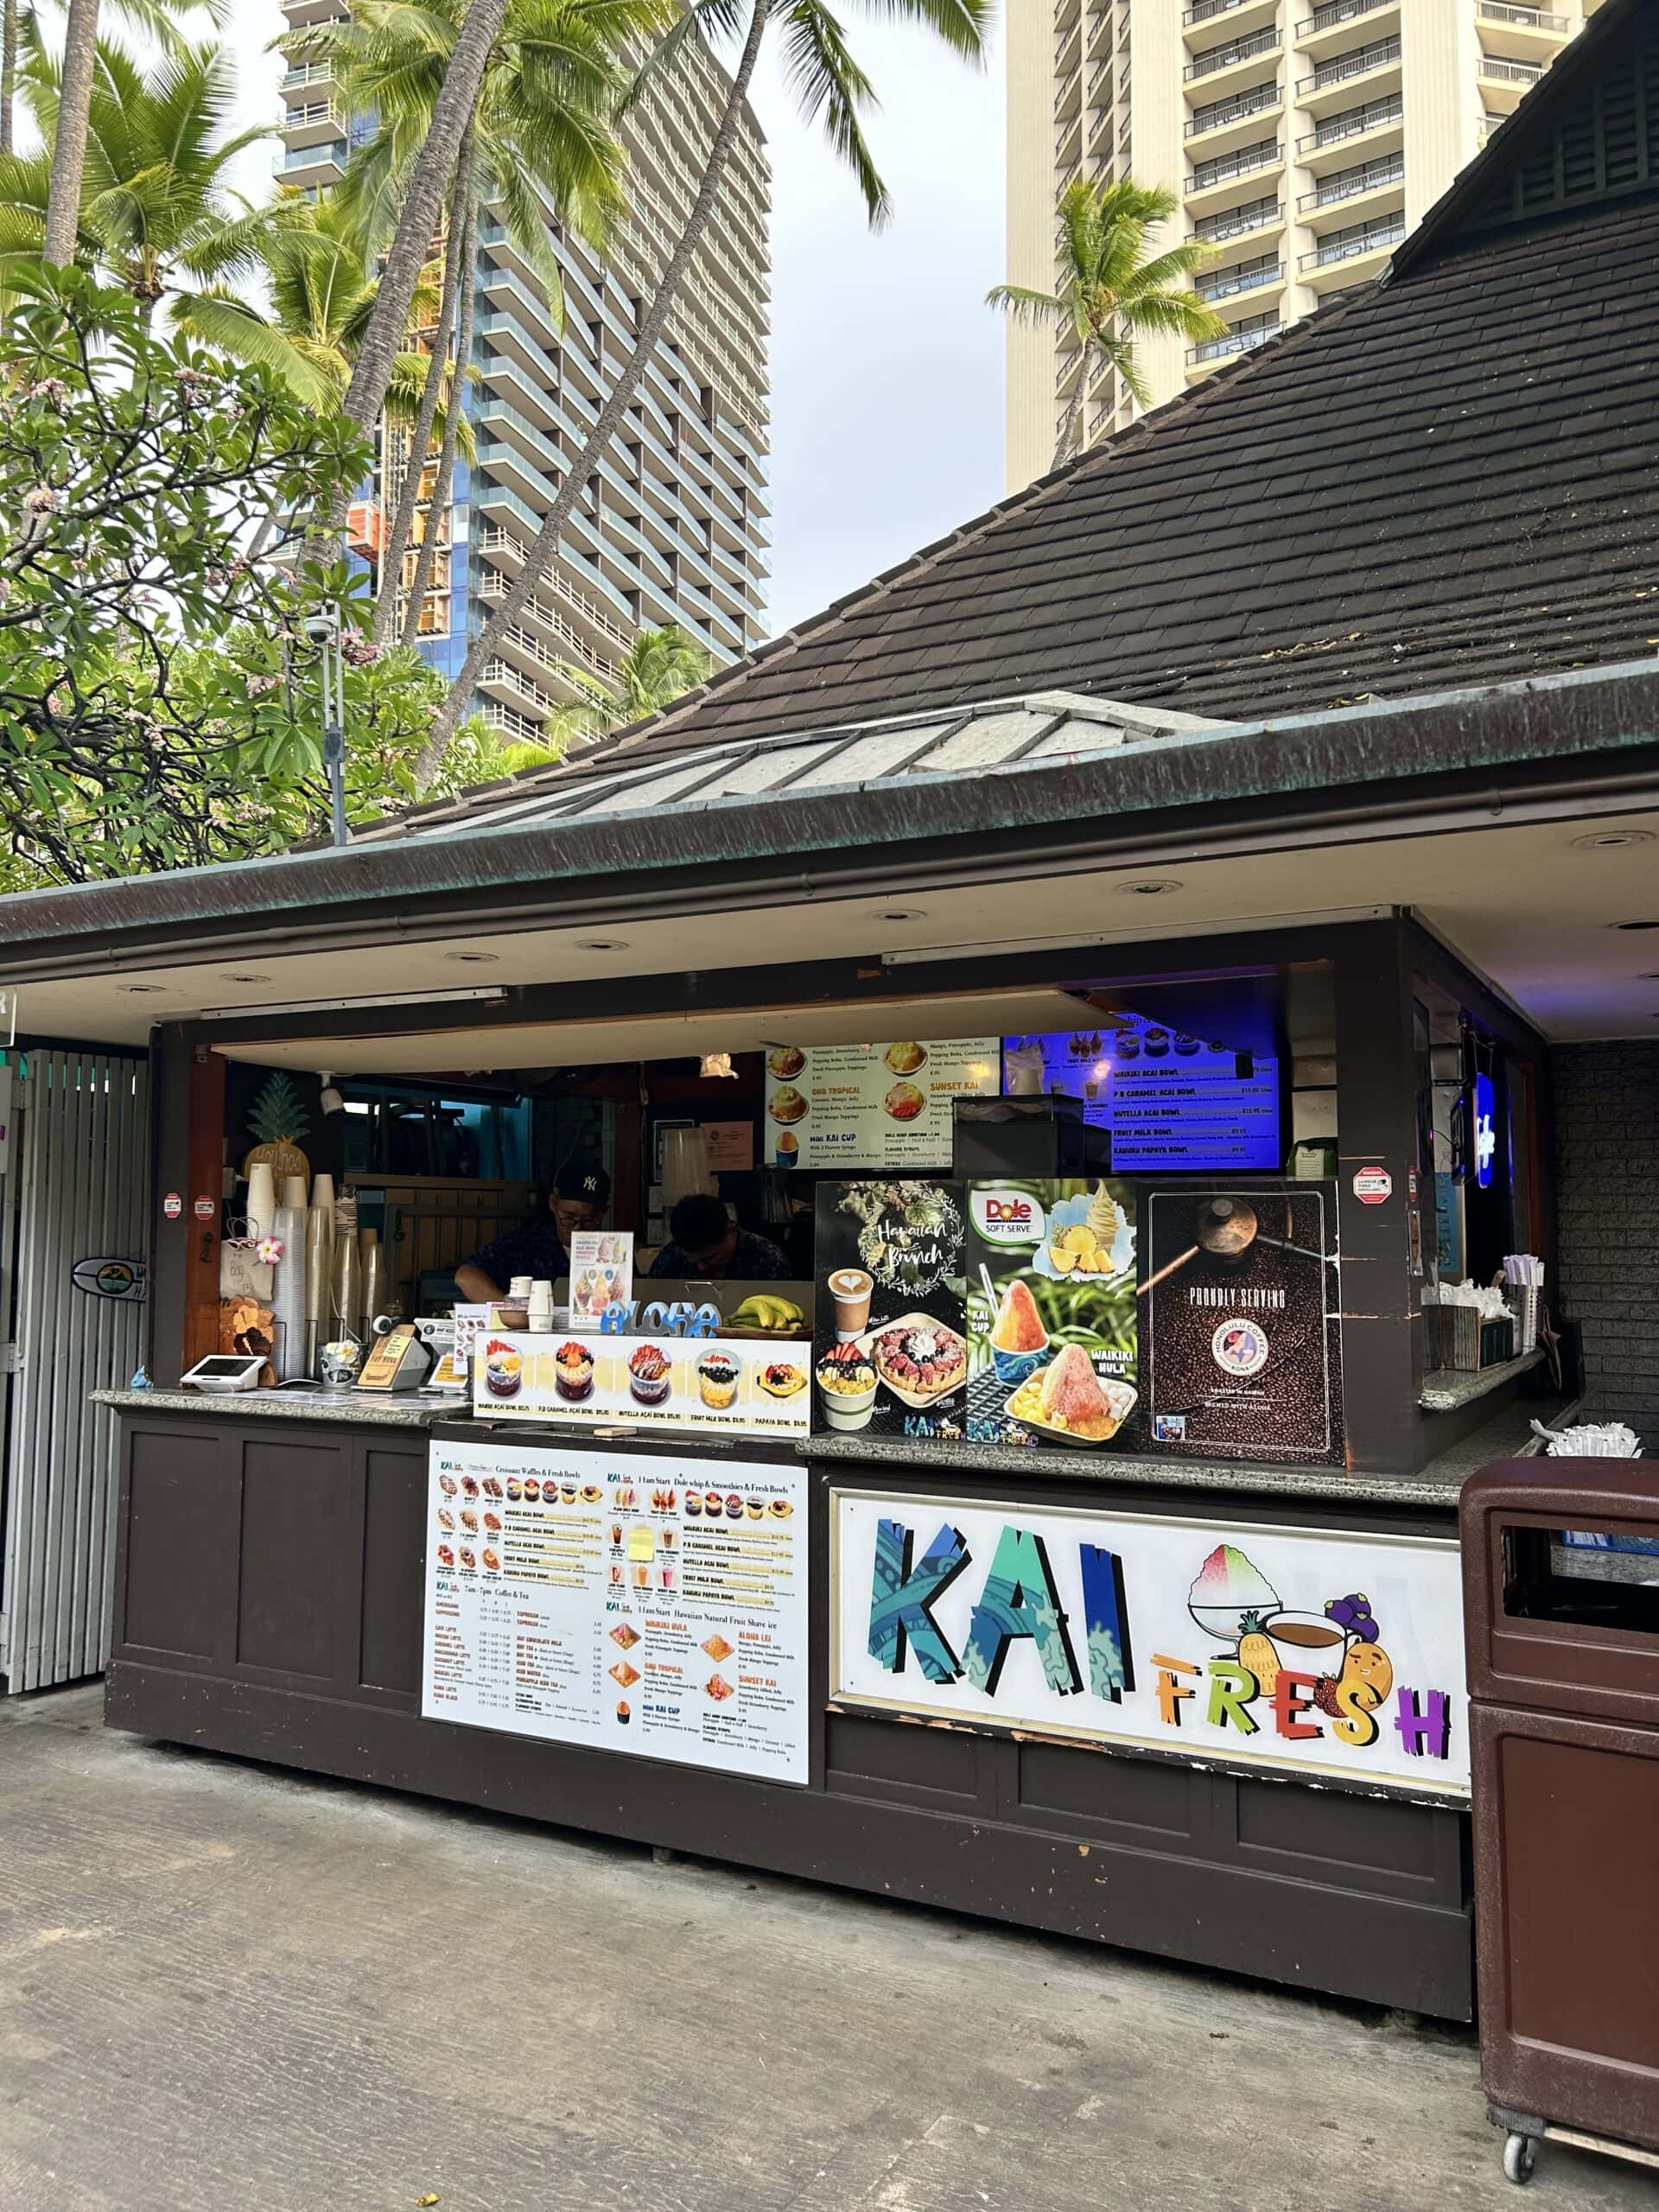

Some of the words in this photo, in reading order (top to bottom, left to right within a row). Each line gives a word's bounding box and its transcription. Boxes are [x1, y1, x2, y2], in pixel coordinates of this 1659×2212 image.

[842, 1133, 856, 1141] CUP
[985, 1198, 1032, 1219] Dole
[877, 1217, 949, 1243] Hawaiian
[986, 1224, 1005, 1233] SOFT
[1007, 1224, 1031, 1233] SERVE
[888, 1243, 944, 1268] Brunch
[1190, 1287, 1236, 1307] PROUDLY
[1241, 1288, 1285, 1309] SERVING
[972, 1310, 988, 1320] KAI
[971, 1322, 990, 1333] CUP
[1216, 1322, 1245, 1353] HONOLULU
[1247, 1325, 1266, 1356] COFFEE
[1091, 1350, 1134, 1363] WAIKIKI
[1098, 1362, 1126, 1375] HULA
[904, 1414, 936, 1439] KAI
[563, 1470, 581, 1479] Bowls
[711, 1480, 743, 1491] Smoothies
[751, 1483, 769, 1493] Fresh
[769, 1484, 788, 1494] Bowls
[494, 1588, 512, 1598] Coffee
[674, 1609, 702, 1621] Hawaiian
[704, 1612, 728, 1623] Natural
[729, 1617, 746, 1626] Fruit
[747, 1618, 766, 1628] Shave
[768, 1621, 778, 1630] ice
[867, 1518, 1136, 1705] KAI
[1148, 1650, 1452, 1760] FRESH
